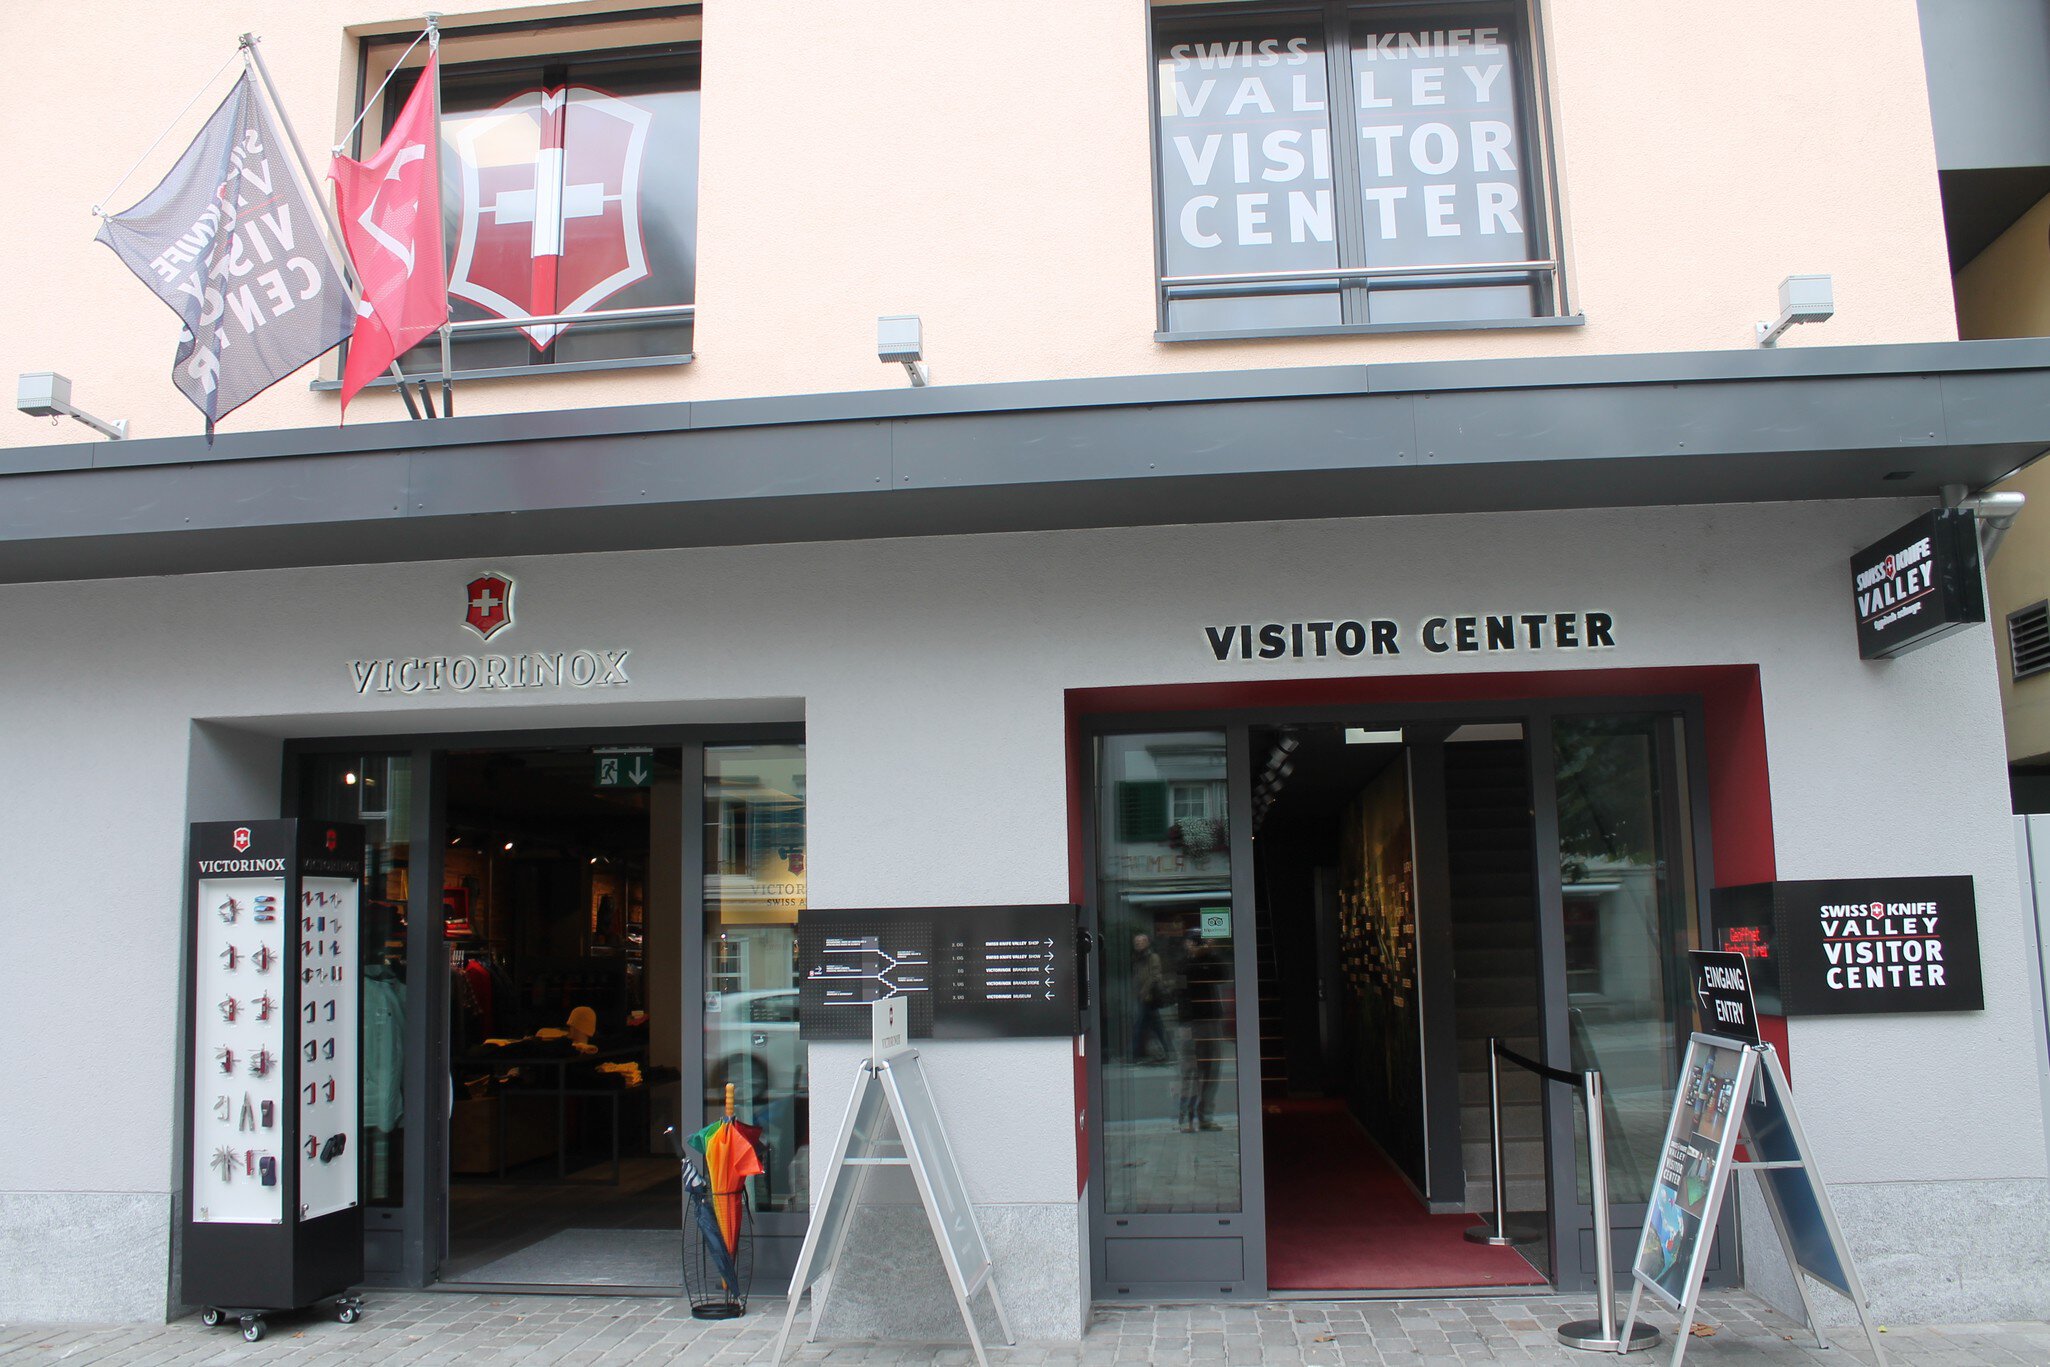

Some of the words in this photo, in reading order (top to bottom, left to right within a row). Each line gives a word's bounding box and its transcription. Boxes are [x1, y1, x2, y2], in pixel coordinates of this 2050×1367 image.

[1169, 37, 1308, 73] SWISS
[1366, 27, 1499, 61] KNIFE
[1173, 65, 1504, 118] VALLEY
[1174, 120, 1516, 186] VISITOR
[1180, 182, 1523, 248] CENTER
[1857, 561, 1886, 592] SWISS
[1896, 537, 1931, 571] KNIFE
[1857, 560, 1933, 618] VALLEY
[1205, 620, 1400, 661] VISITOR
[1423, 612, 1616, 653] CENTER
[346, 649, 632, 694] VICTORINOX
[199, 858, 286, 873] VICTORINOX
[767, 898, 796, 906] SWISS
[1820, 904, 1868, 918] SWISS
[1886, 901, 1937, 916] KNIFE
[1820, 917, 1939, 937] VALLEY
[1823, 940, 1943, 965] VISITOR
[1704, 966, 1745, 992] EINGANG
[1826, 964, 1946, 990] CENTER
[1715, 999, 1745, 1025] ENTRY
